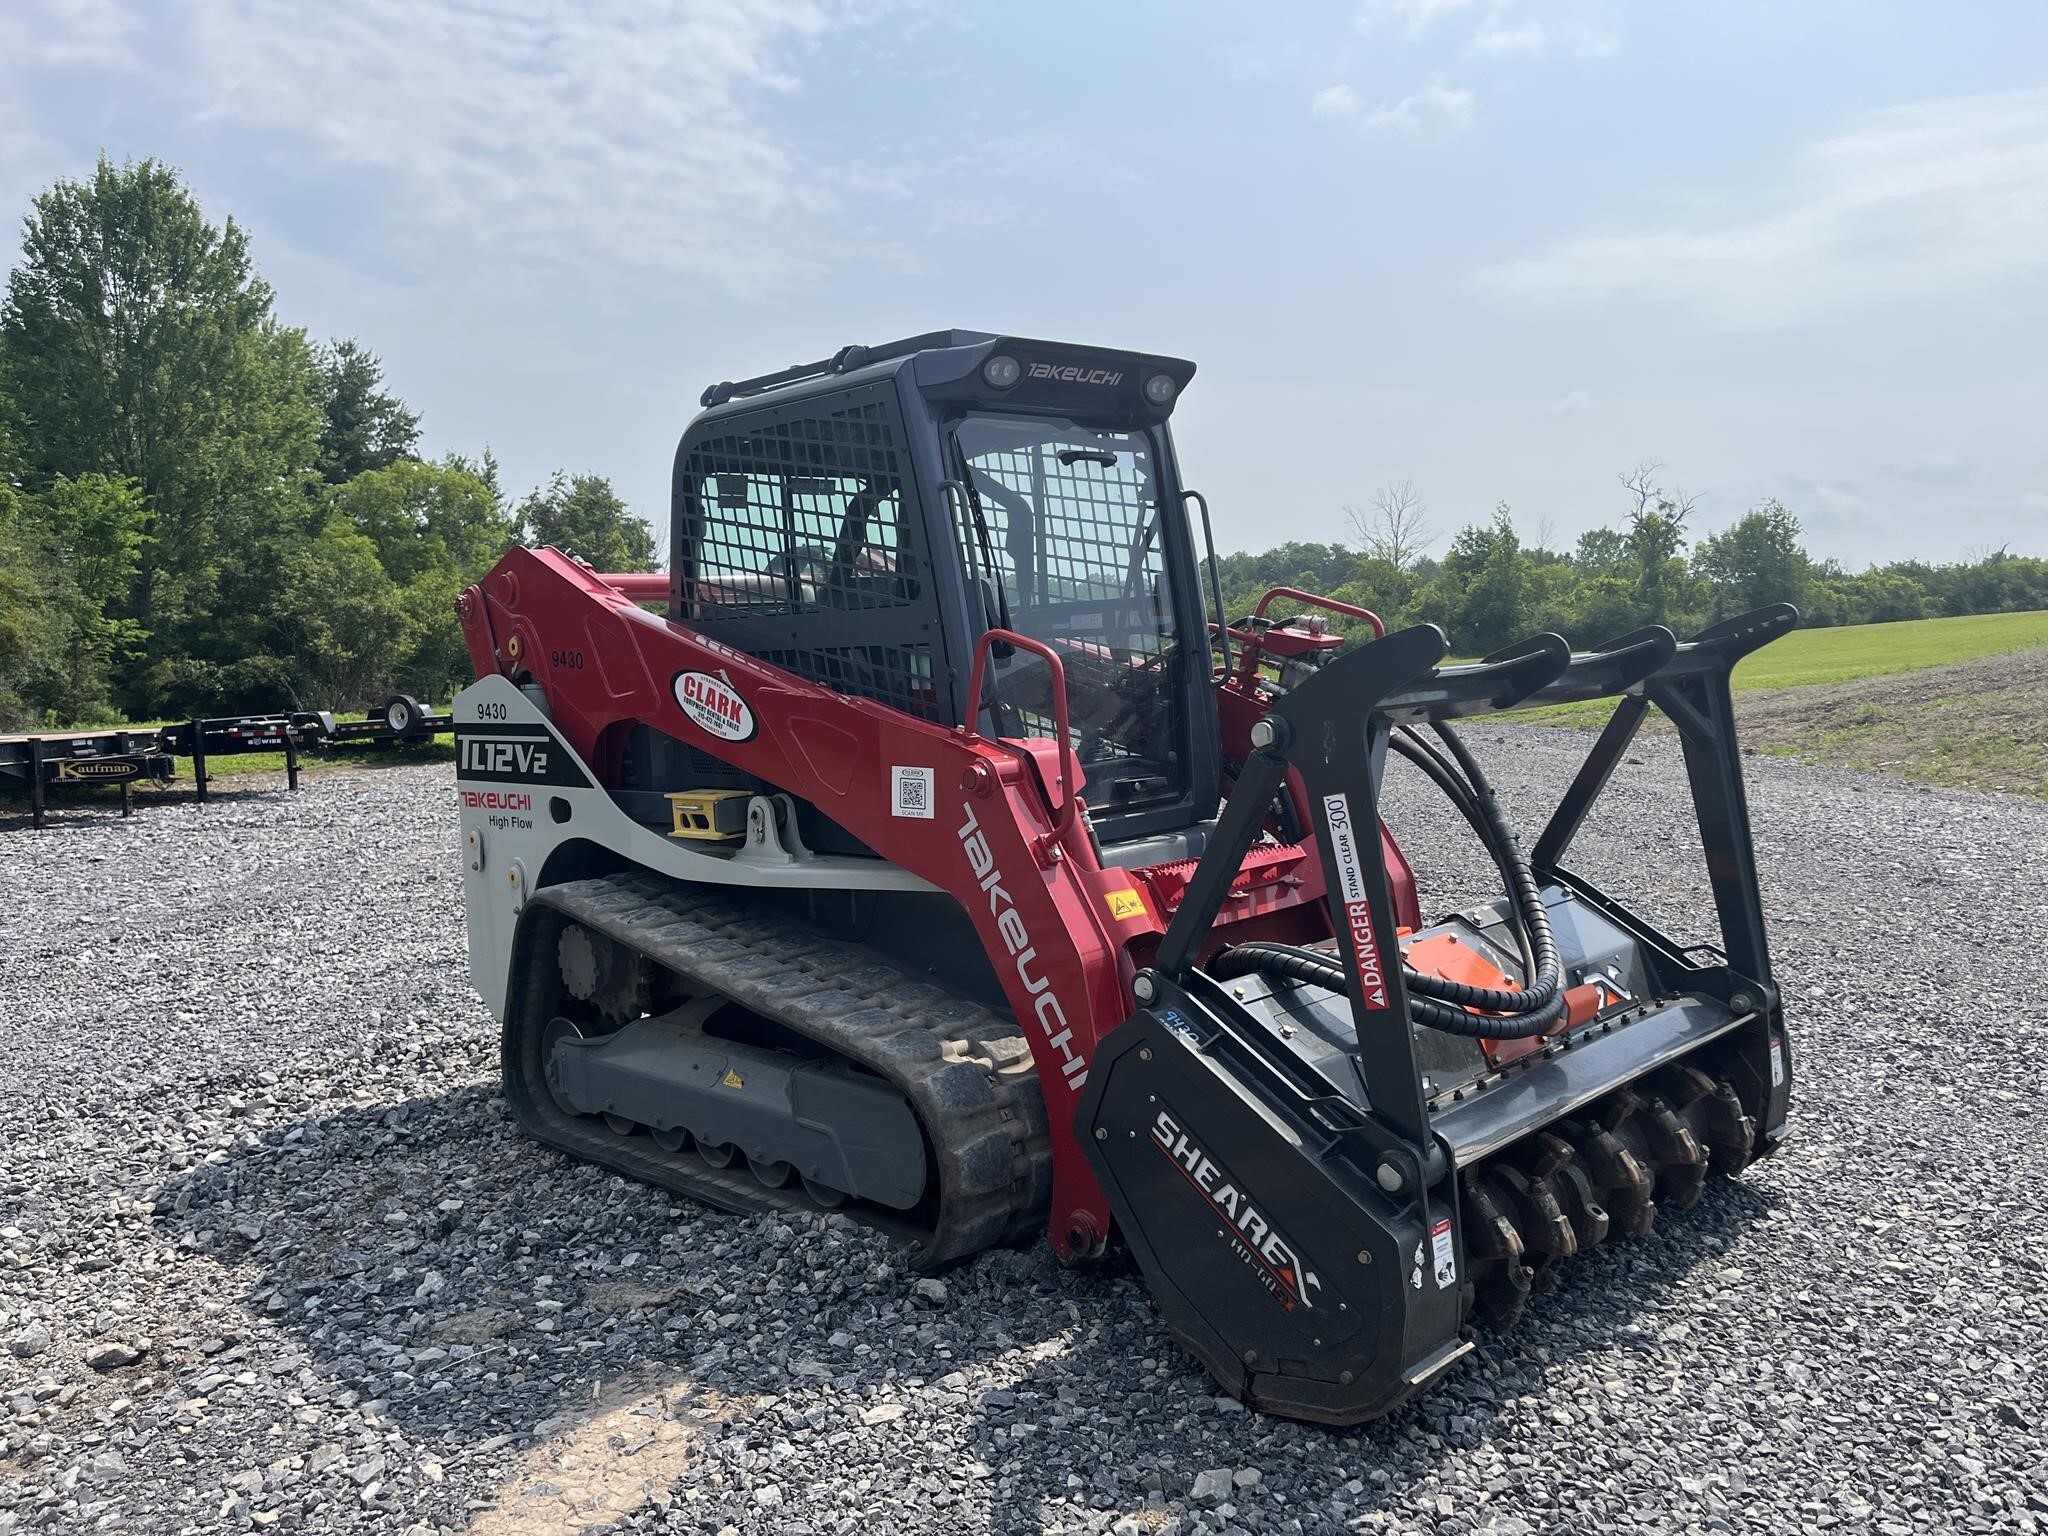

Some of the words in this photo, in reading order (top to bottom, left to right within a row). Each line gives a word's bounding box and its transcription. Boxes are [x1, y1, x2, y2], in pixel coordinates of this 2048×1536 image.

[552, 651, 584, 670] 9430
[477, 703, 507, 720] 9430
[683, 675, 743, 725] CLARK
[683, 696, 707, 713] EQUIPMENT
[706, 708, 723, 722] RENTAL
[726, 719, 740, 732] SALES
[59, 760, 131, 778] Kaufman
[460, 791, 532, 811] TAKEUCHI
[489, 815, 509, 830] High
[511, 816, 533, 829] Flow
[1340, 834, 1353, 864] CLEAR
[1345, 866, 1360, 898] STAND
[1350, 903, 1382, 987] DANGER
[1167, 1011, 1200, 1042] 9430
[1151, 1111, 1322, 1308] SHEAREX
